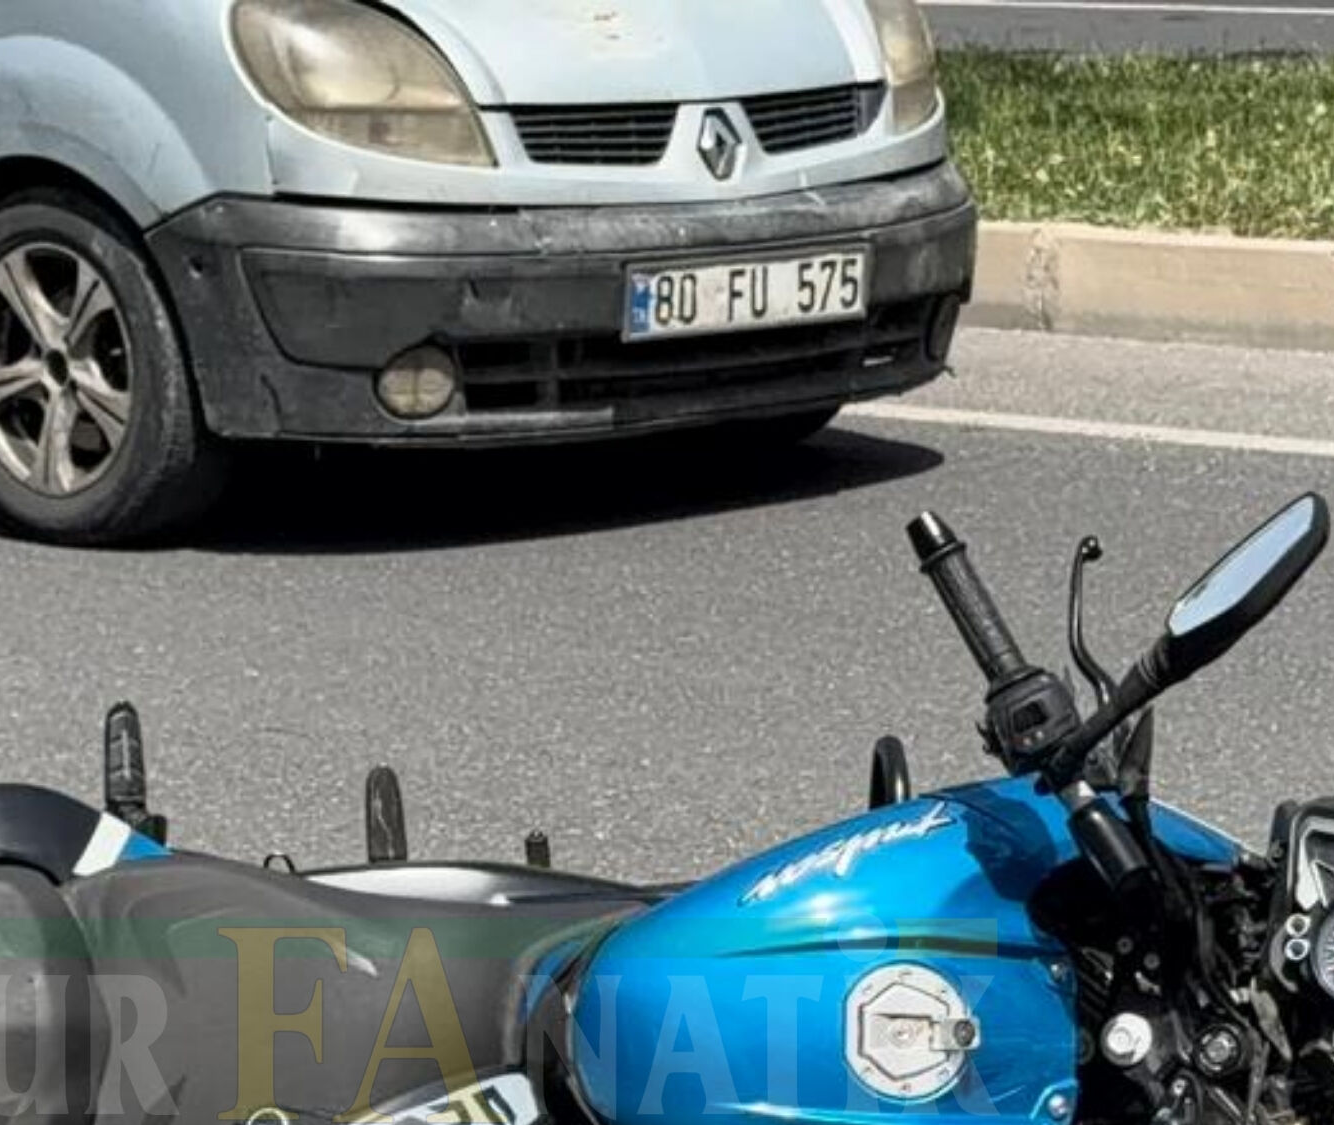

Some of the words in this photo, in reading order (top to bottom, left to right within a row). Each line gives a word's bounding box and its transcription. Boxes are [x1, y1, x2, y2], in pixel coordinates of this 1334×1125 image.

[654, 272, 697, 326] 80
[727, 265, 768, 323] FU
[796, 258, 859, 314] 575
